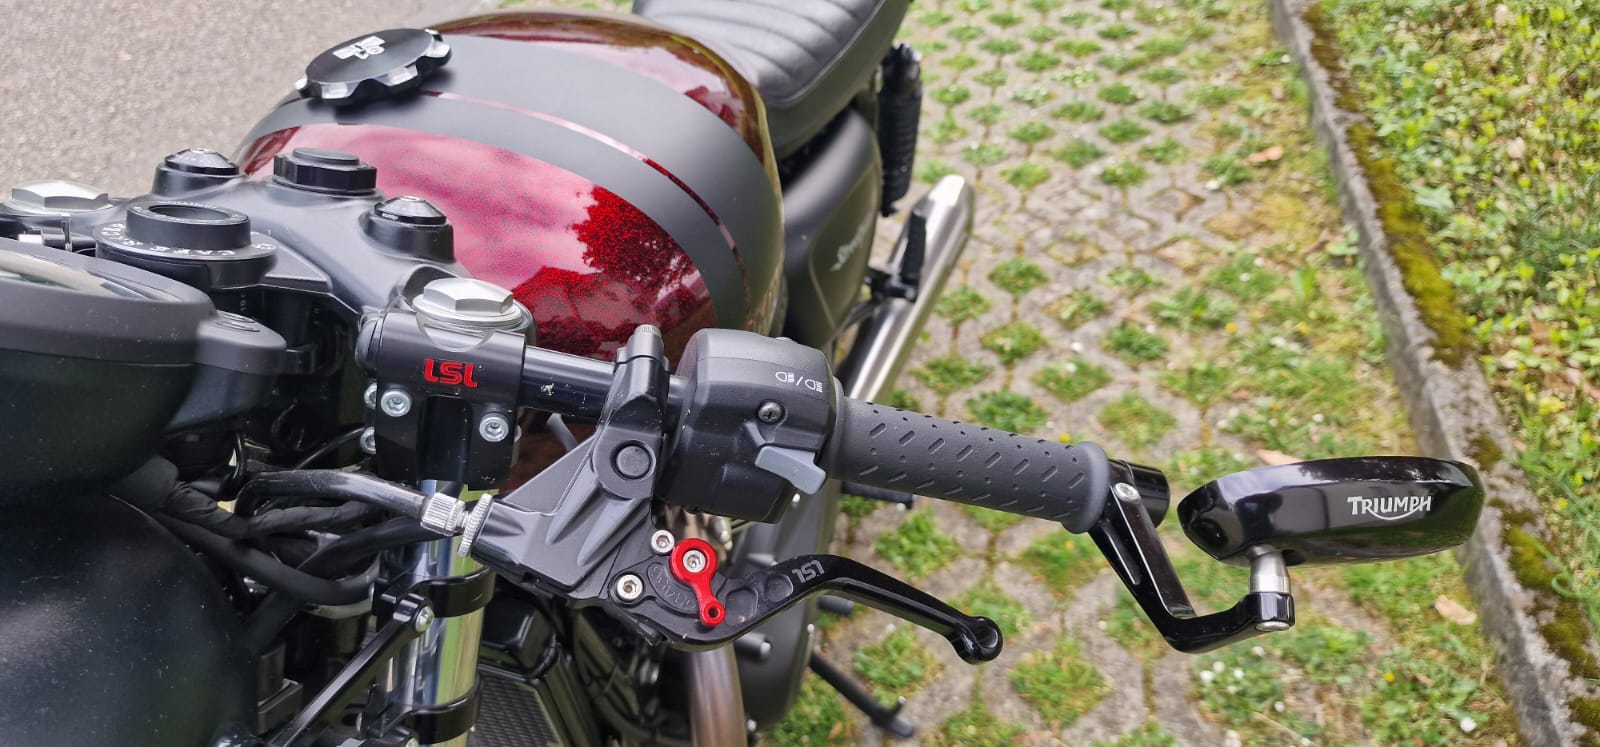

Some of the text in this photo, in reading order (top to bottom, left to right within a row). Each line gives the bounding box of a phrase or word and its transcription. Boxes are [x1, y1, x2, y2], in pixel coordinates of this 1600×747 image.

[424, 357, 478, 388] LSL
[1347, 495, 1432, 520] TRIUMPH
[791, 559, 825, 584] LSL
